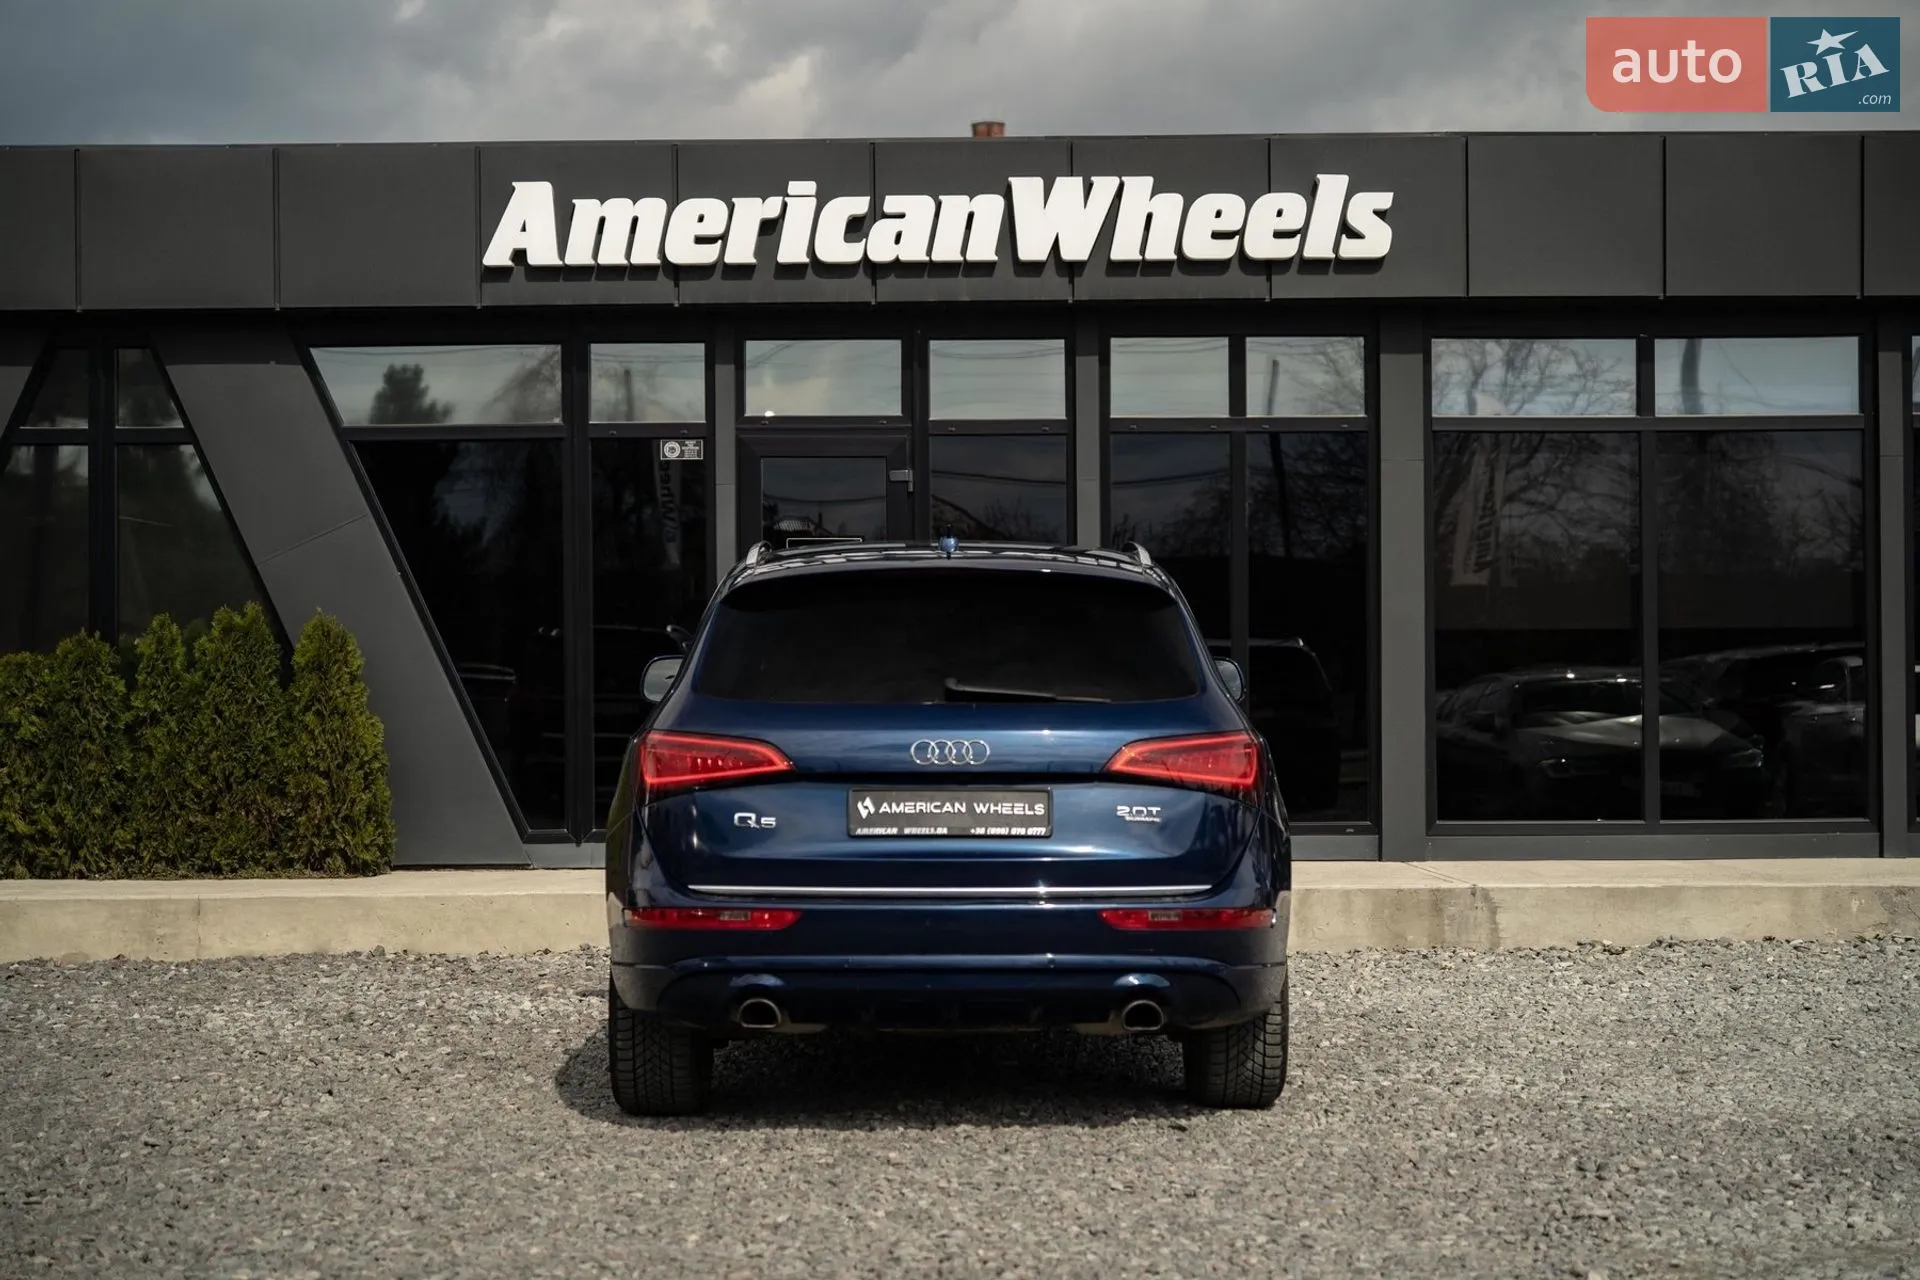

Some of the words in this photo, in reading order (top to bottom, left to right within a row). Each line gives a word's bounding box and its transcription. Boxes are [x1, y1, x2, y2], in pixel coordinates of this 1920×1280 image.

[482, 173, 1395, 267] AmericanWheels
[879, 801, 967, 814] AMERICAN
[974, 802, 1046, 815] WHEELS
[733, 812, 777, 829] Q5
